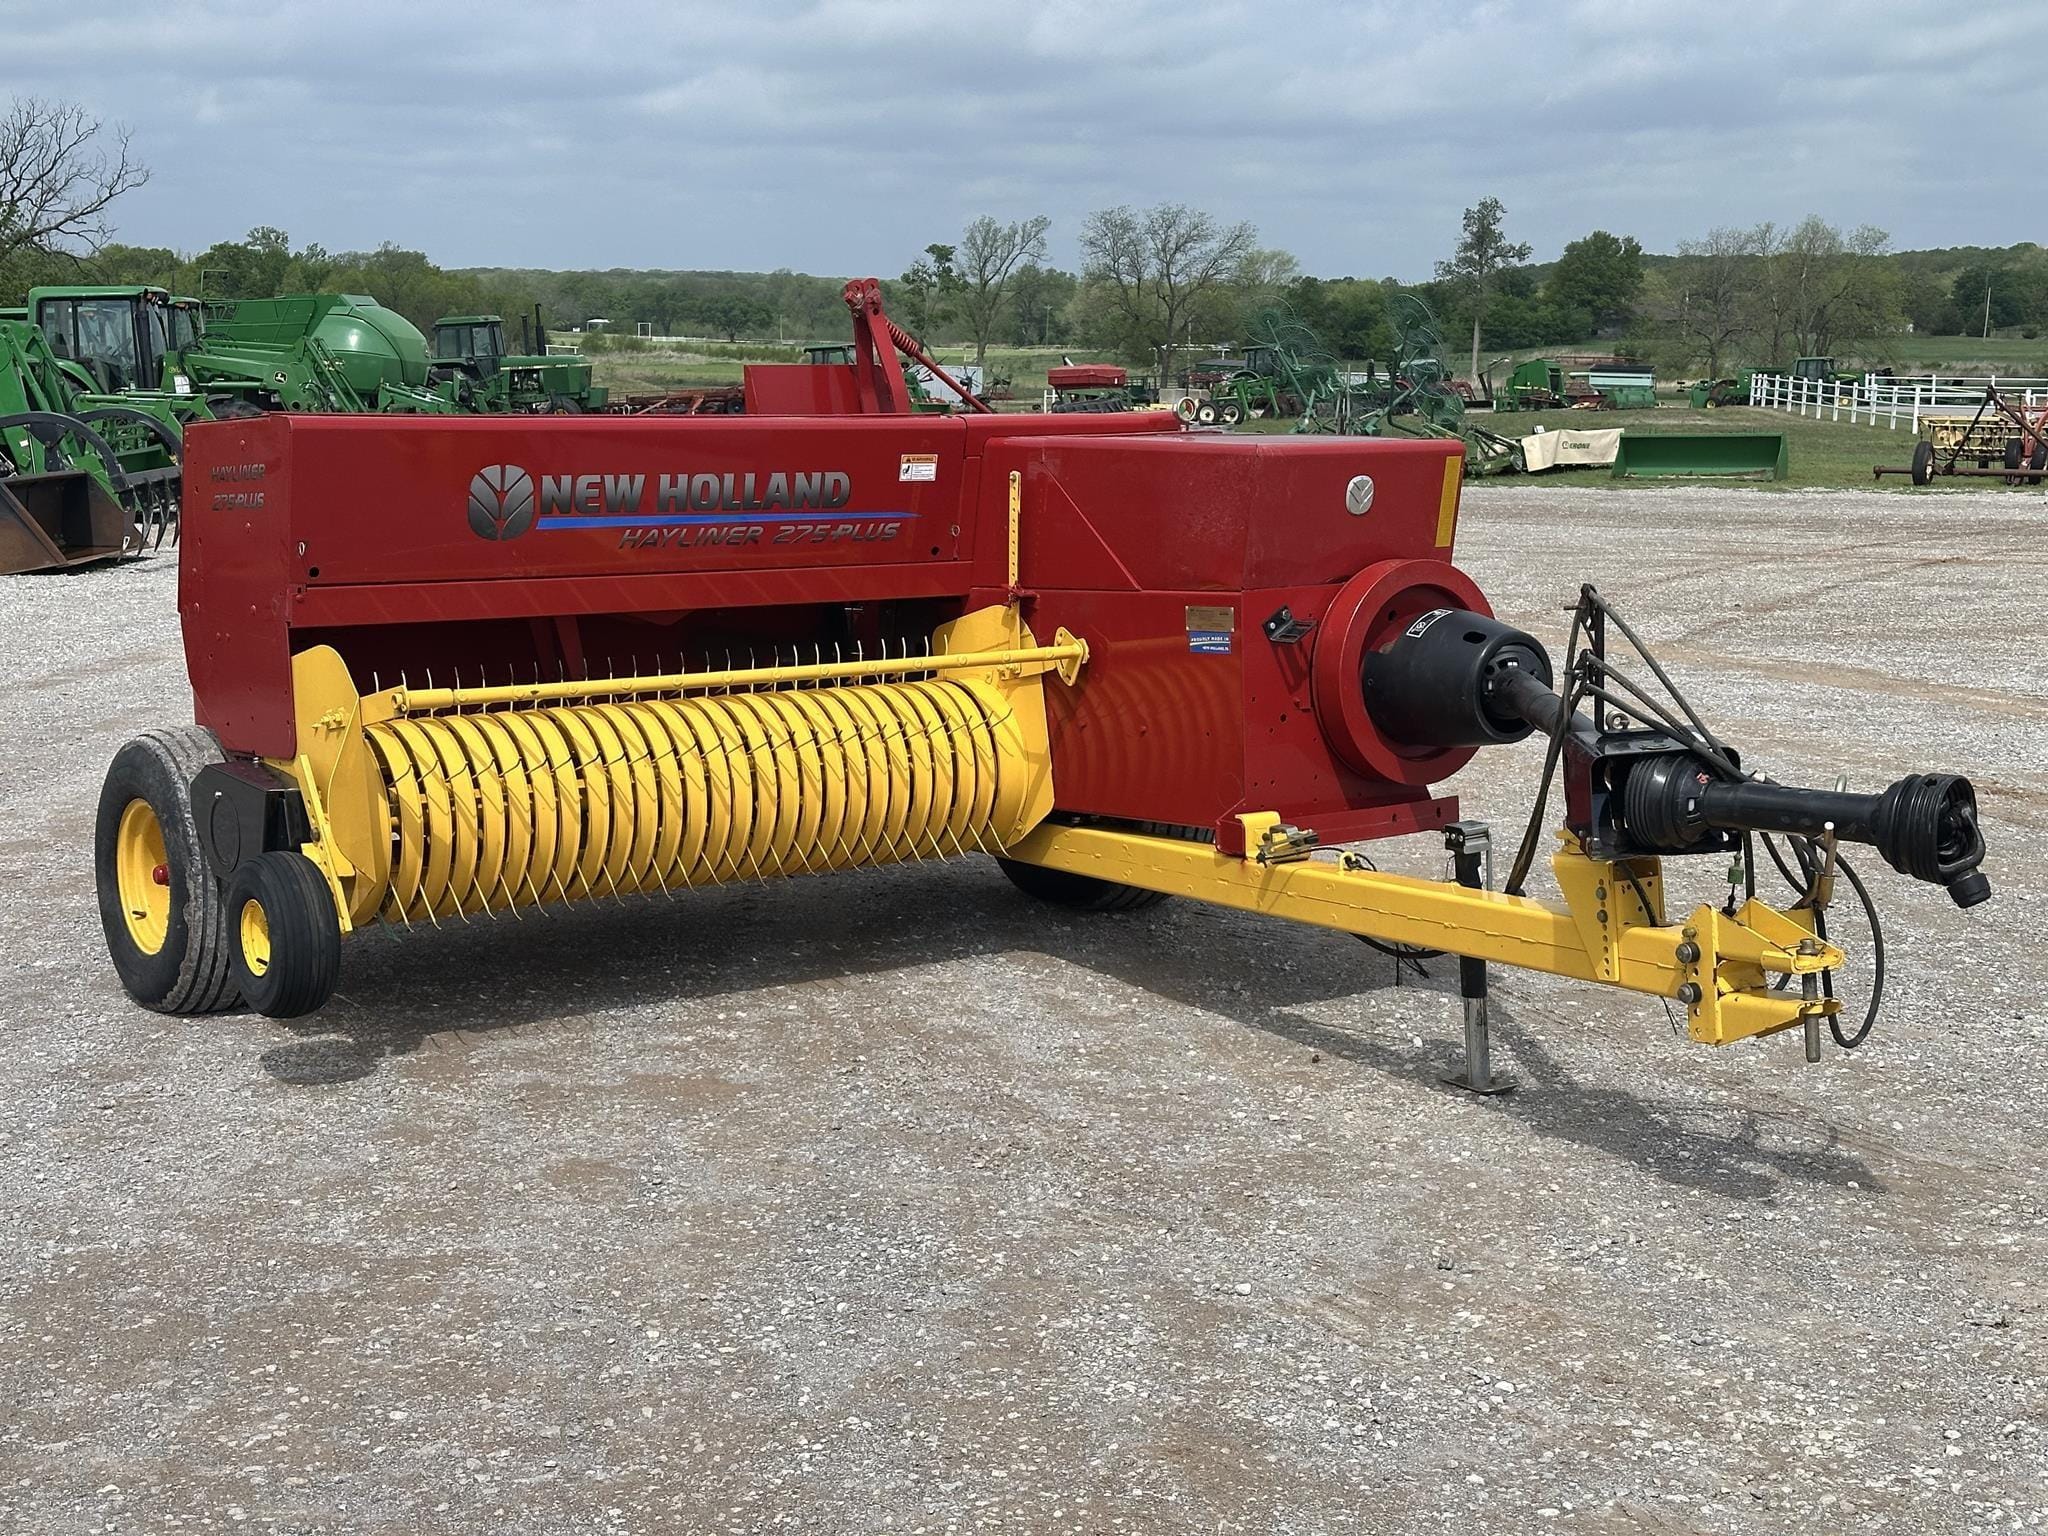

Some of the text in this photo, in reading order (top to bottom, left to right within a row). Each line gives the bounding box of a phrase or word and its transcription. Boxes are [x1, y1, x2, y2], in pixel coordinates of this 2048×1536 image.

[211, 464, 266, 481] HAYLINER
[540, 472, 851, 514] NEW HOLLAND
[618, 526, 764, 550] HAYLINER
